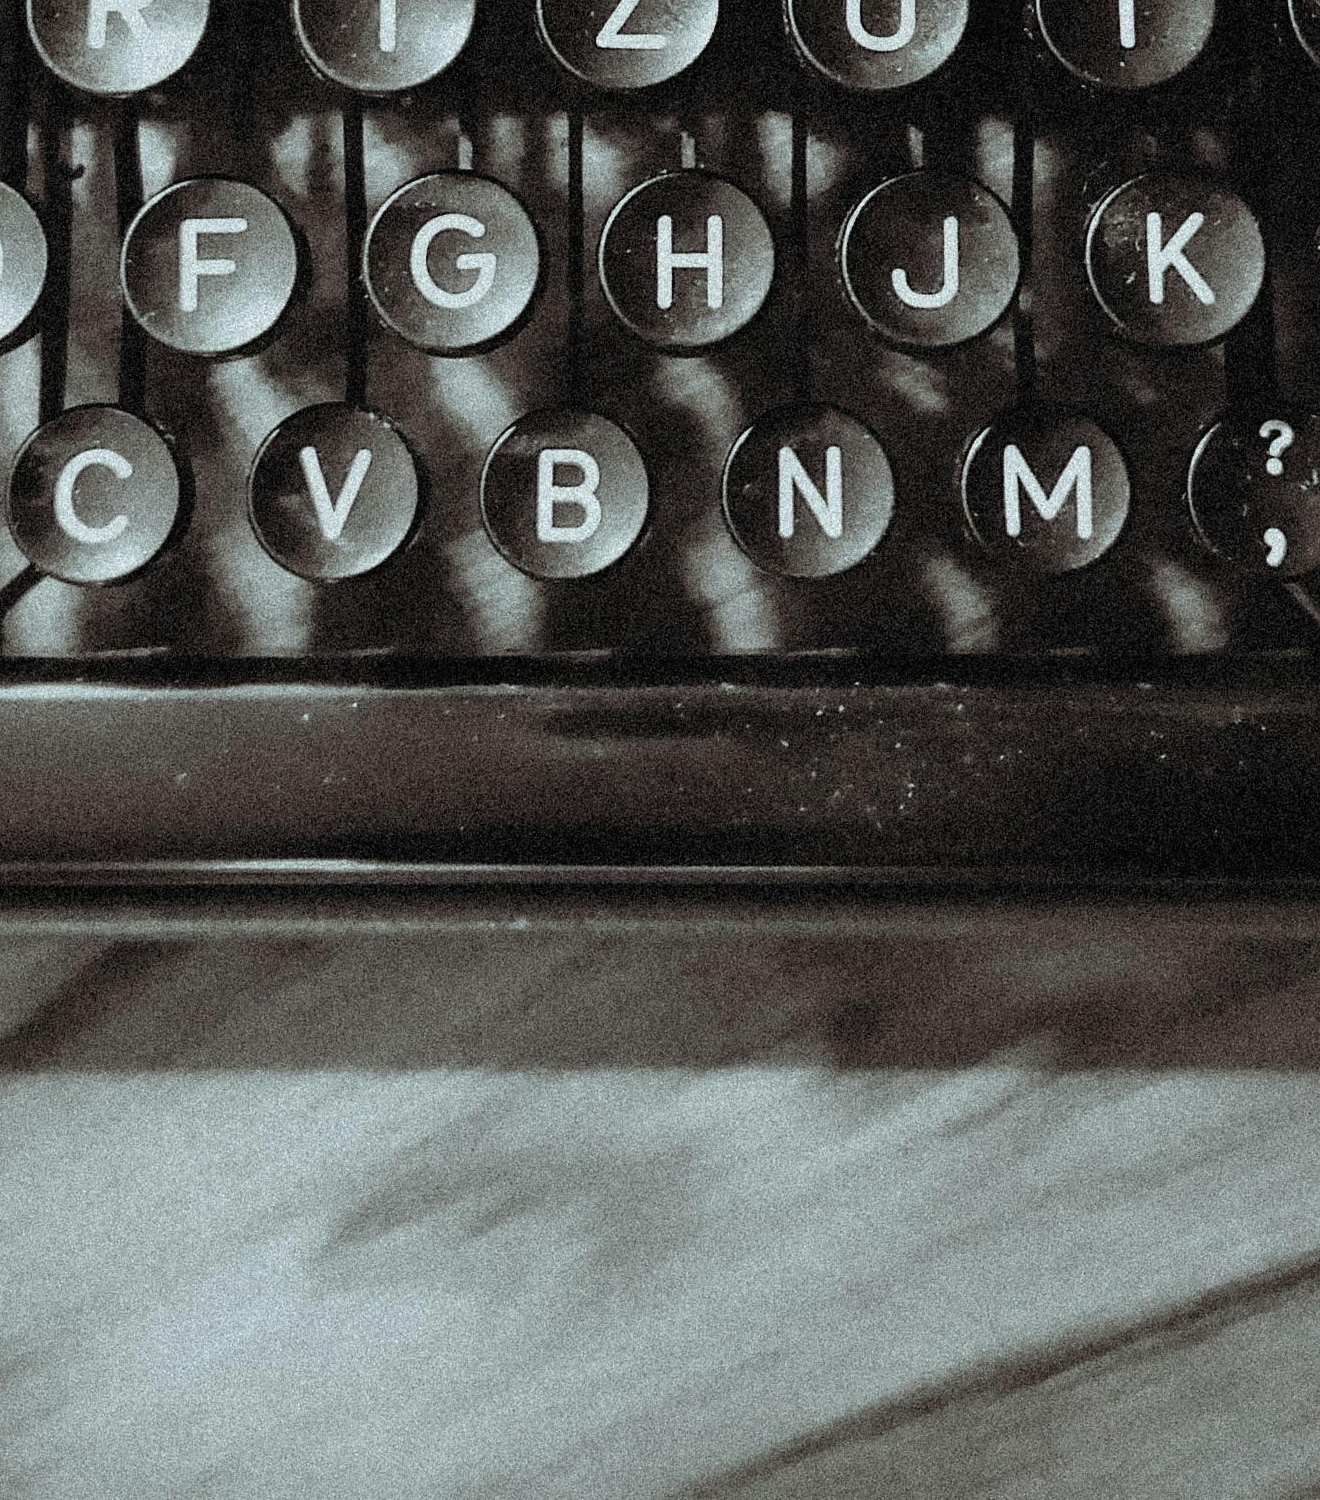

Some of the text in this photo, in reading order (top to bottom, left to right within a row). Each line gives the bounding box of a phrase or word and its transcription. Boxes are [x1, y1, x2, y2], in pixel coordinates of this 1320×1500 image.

[179, 218, 247, 312] F
[411, 213, 497, 309] G
[657, 214, 723, 309] H
[891, 216, 959, 309] J
[1147, 211, 1215, 304] K
[299, 445, 372, 540] V
[778, 445, 843, 539] N
[1003, 444, 1093, 540] M
[1259, 420, 1294, 475] ?
[53, 448, 133, 544] C
[537, 448, 603, 542] B
